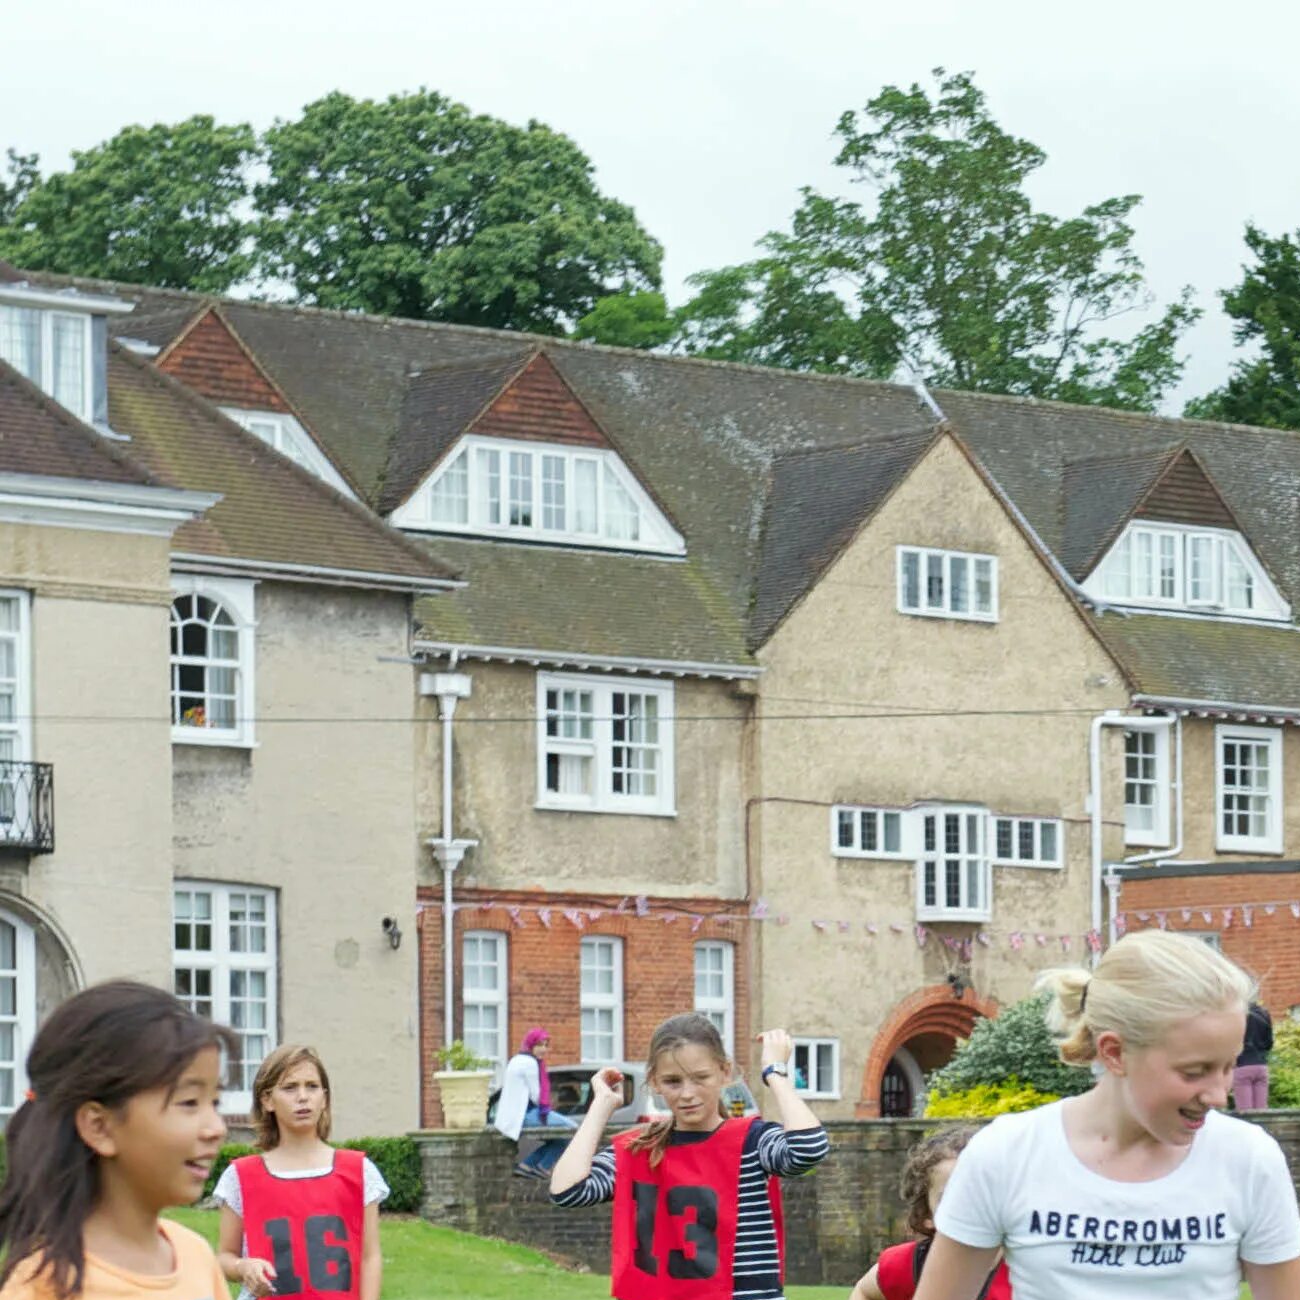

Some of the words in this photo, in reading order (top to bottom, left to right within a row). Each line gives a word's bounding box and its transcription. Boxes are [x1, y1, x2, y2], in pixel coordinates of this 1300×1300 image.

[631, 1180, 718, 1279] 13
[1029, 1209, 1226, 1242] ABERCROMBIE
[1134, 1242, 1188, 1267] Club
[264, 1214, 352, 1297] 16
